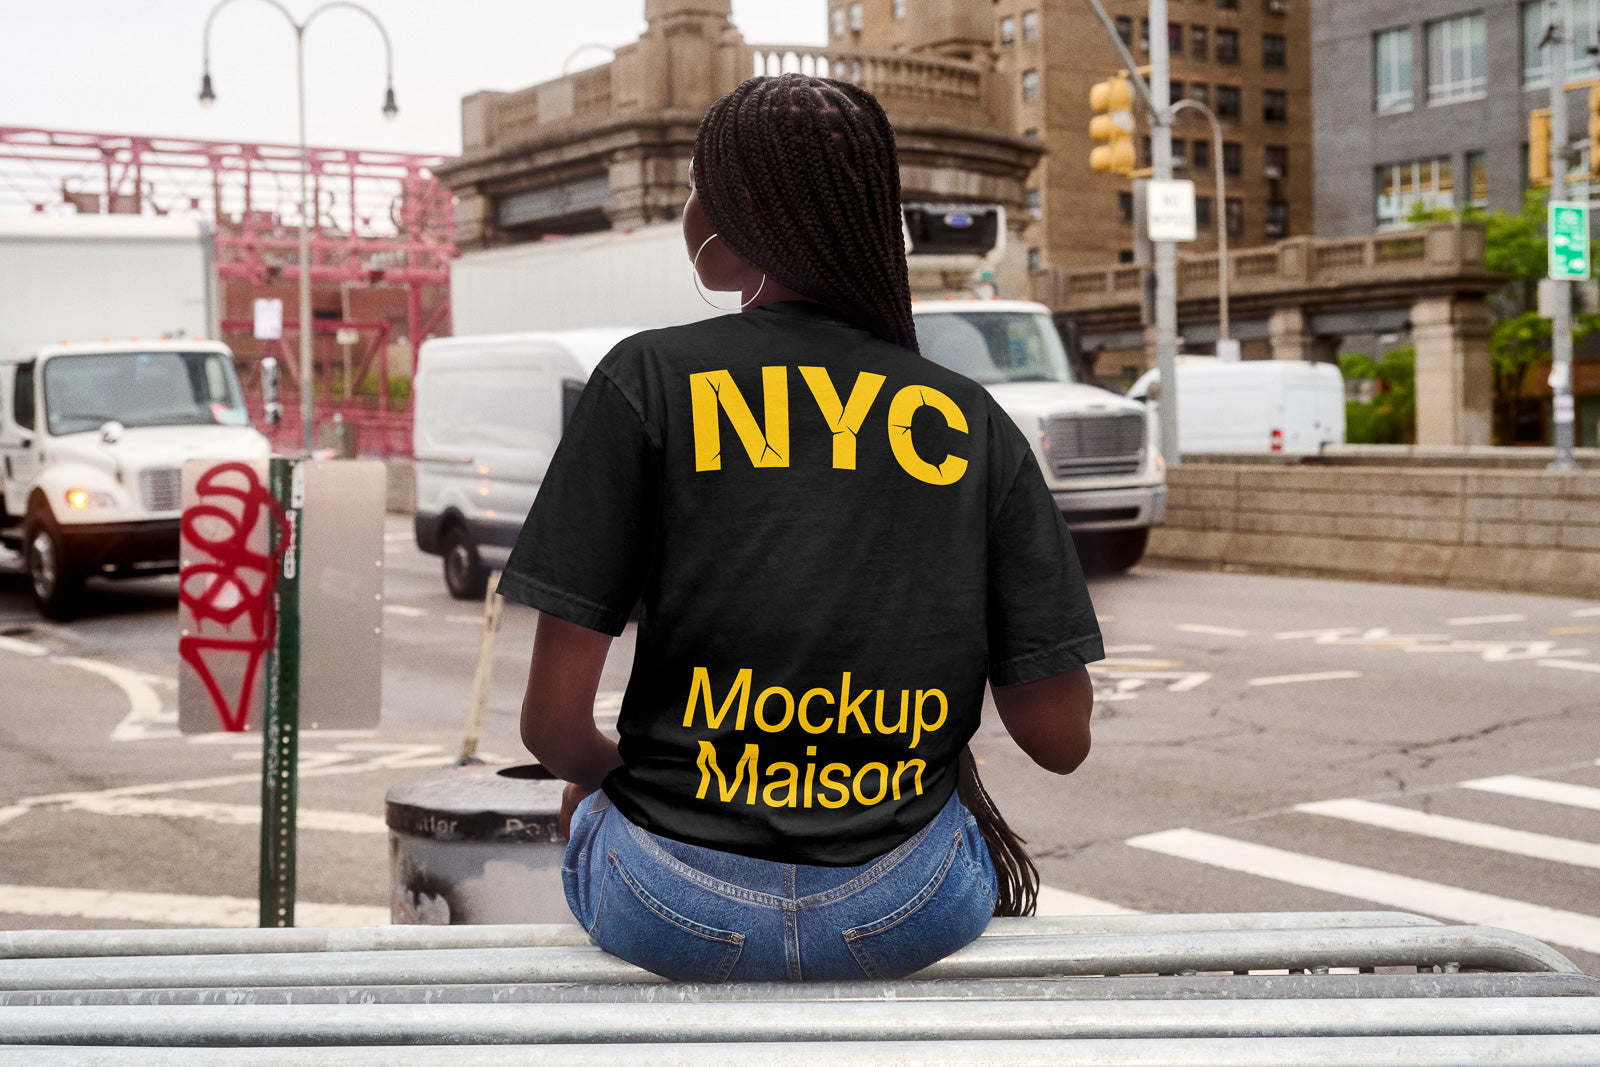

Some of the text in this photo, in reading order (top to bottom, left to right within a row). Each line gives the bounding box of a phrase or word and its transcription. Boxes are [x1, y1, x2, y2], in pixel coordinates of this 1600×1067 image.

[689, 365, 969, 486] NYC
[682, 667, 949, 749] Mockup
[695, 740, 927, 809] Maison
